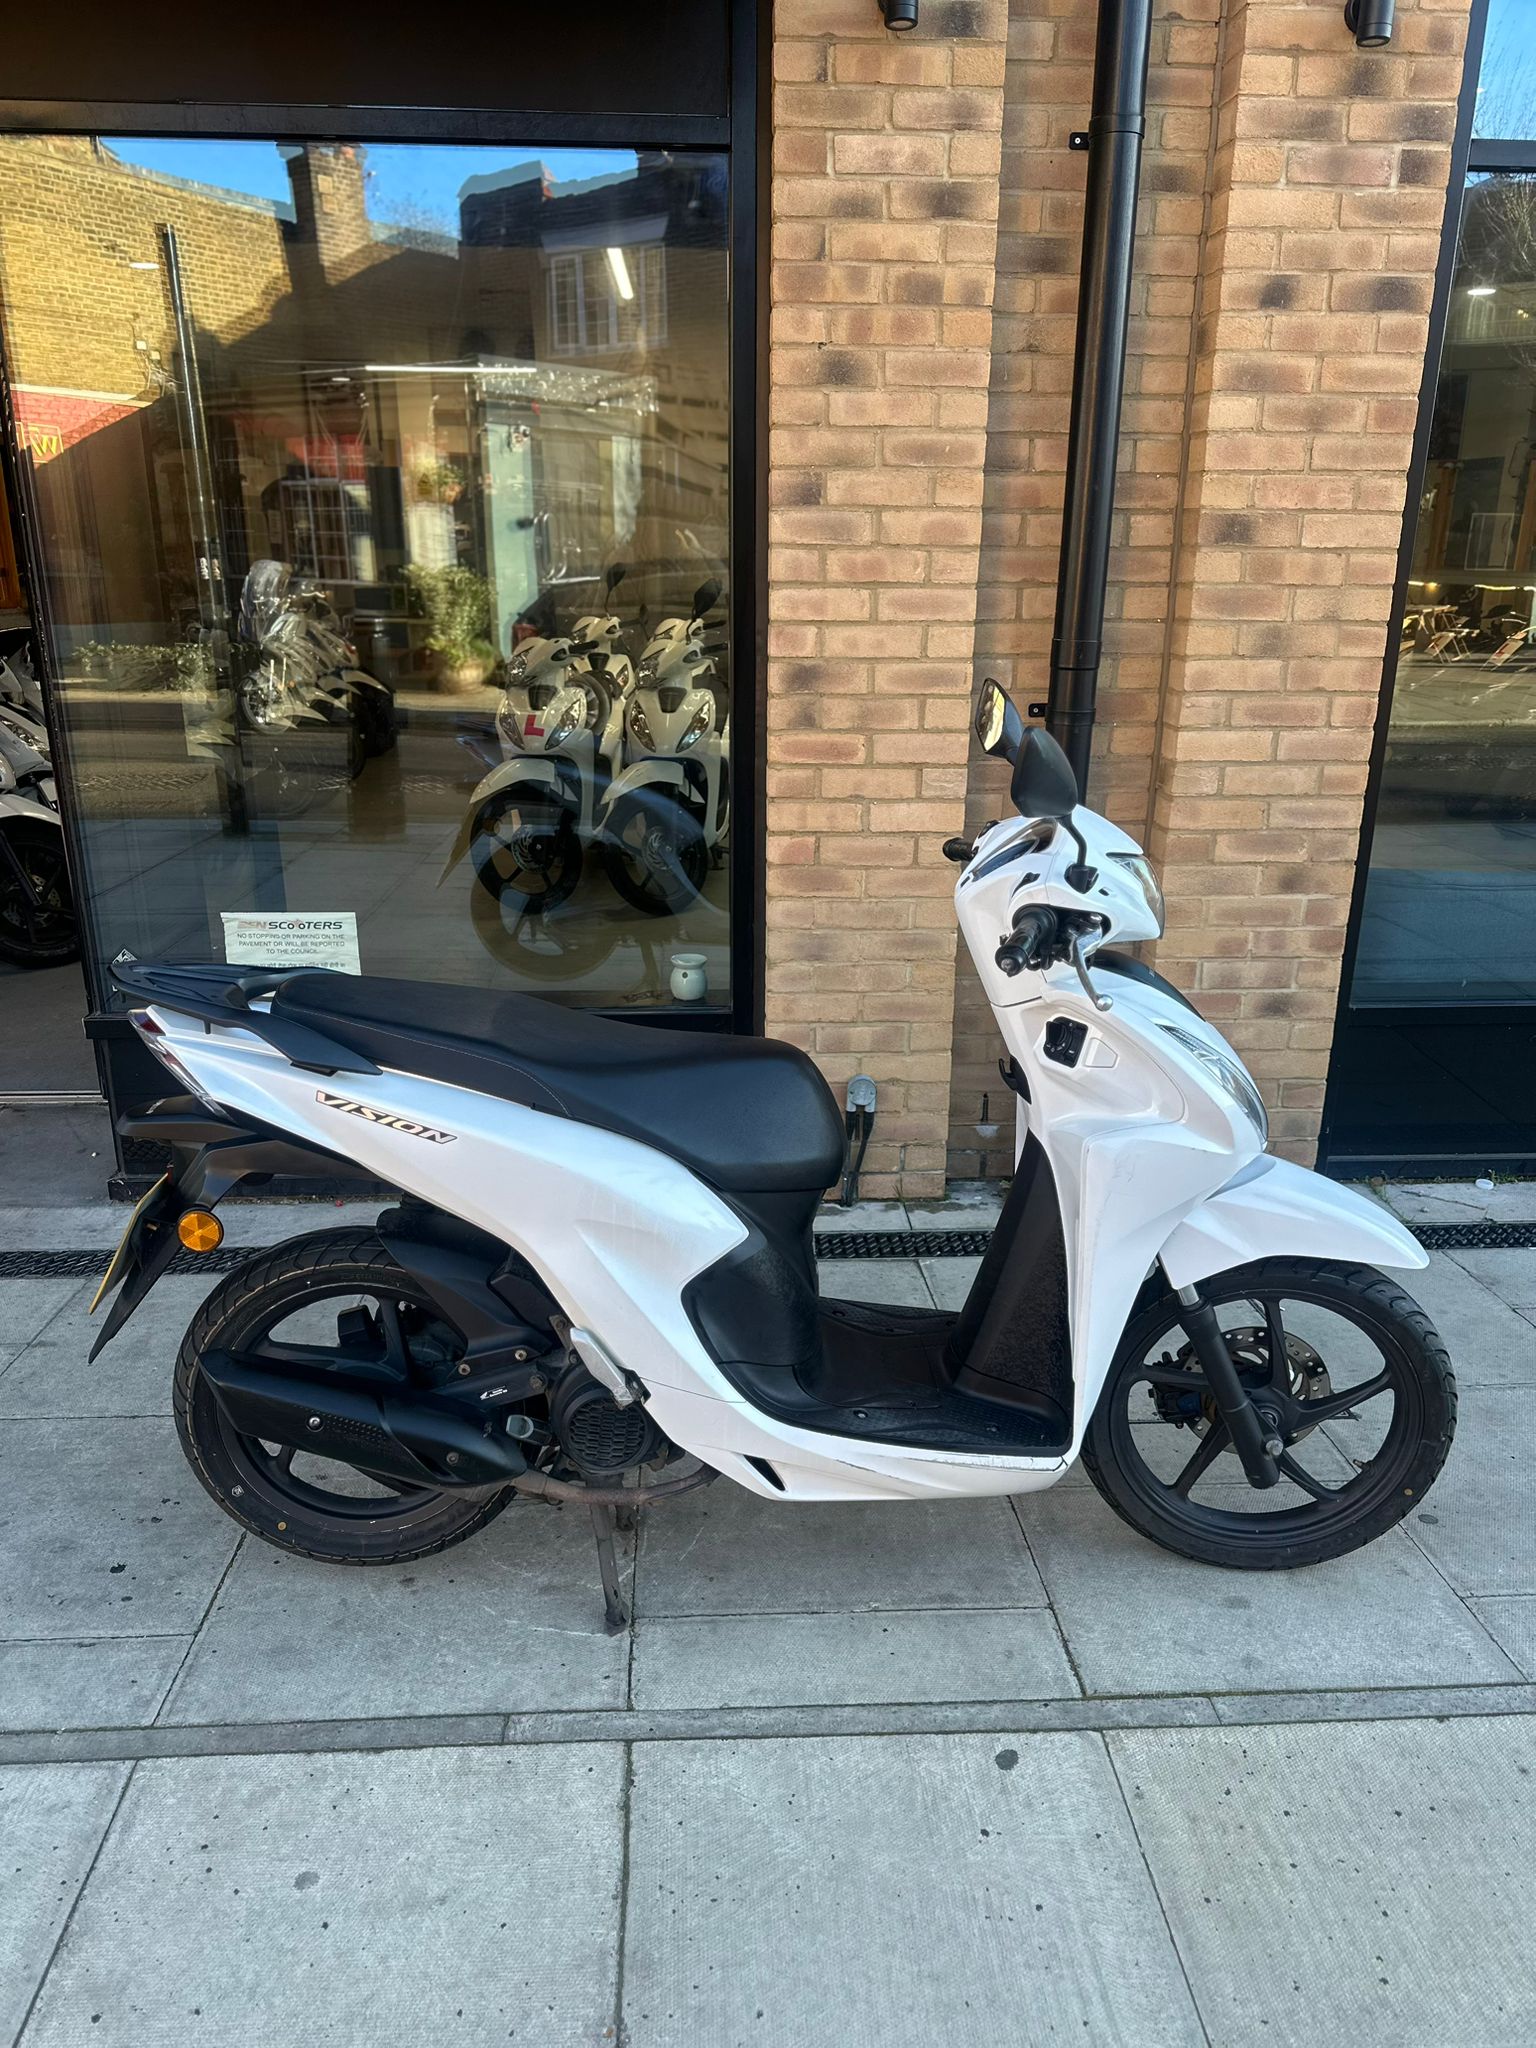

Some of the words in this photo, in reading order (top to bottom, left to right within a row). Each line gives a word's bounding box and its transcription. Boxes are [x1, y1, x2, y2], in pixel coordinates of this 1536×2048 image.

[524, 714, 545, 737] L
[284, 940, 299, 948] WILL
[316, 1090, 458, 1144] VISION
